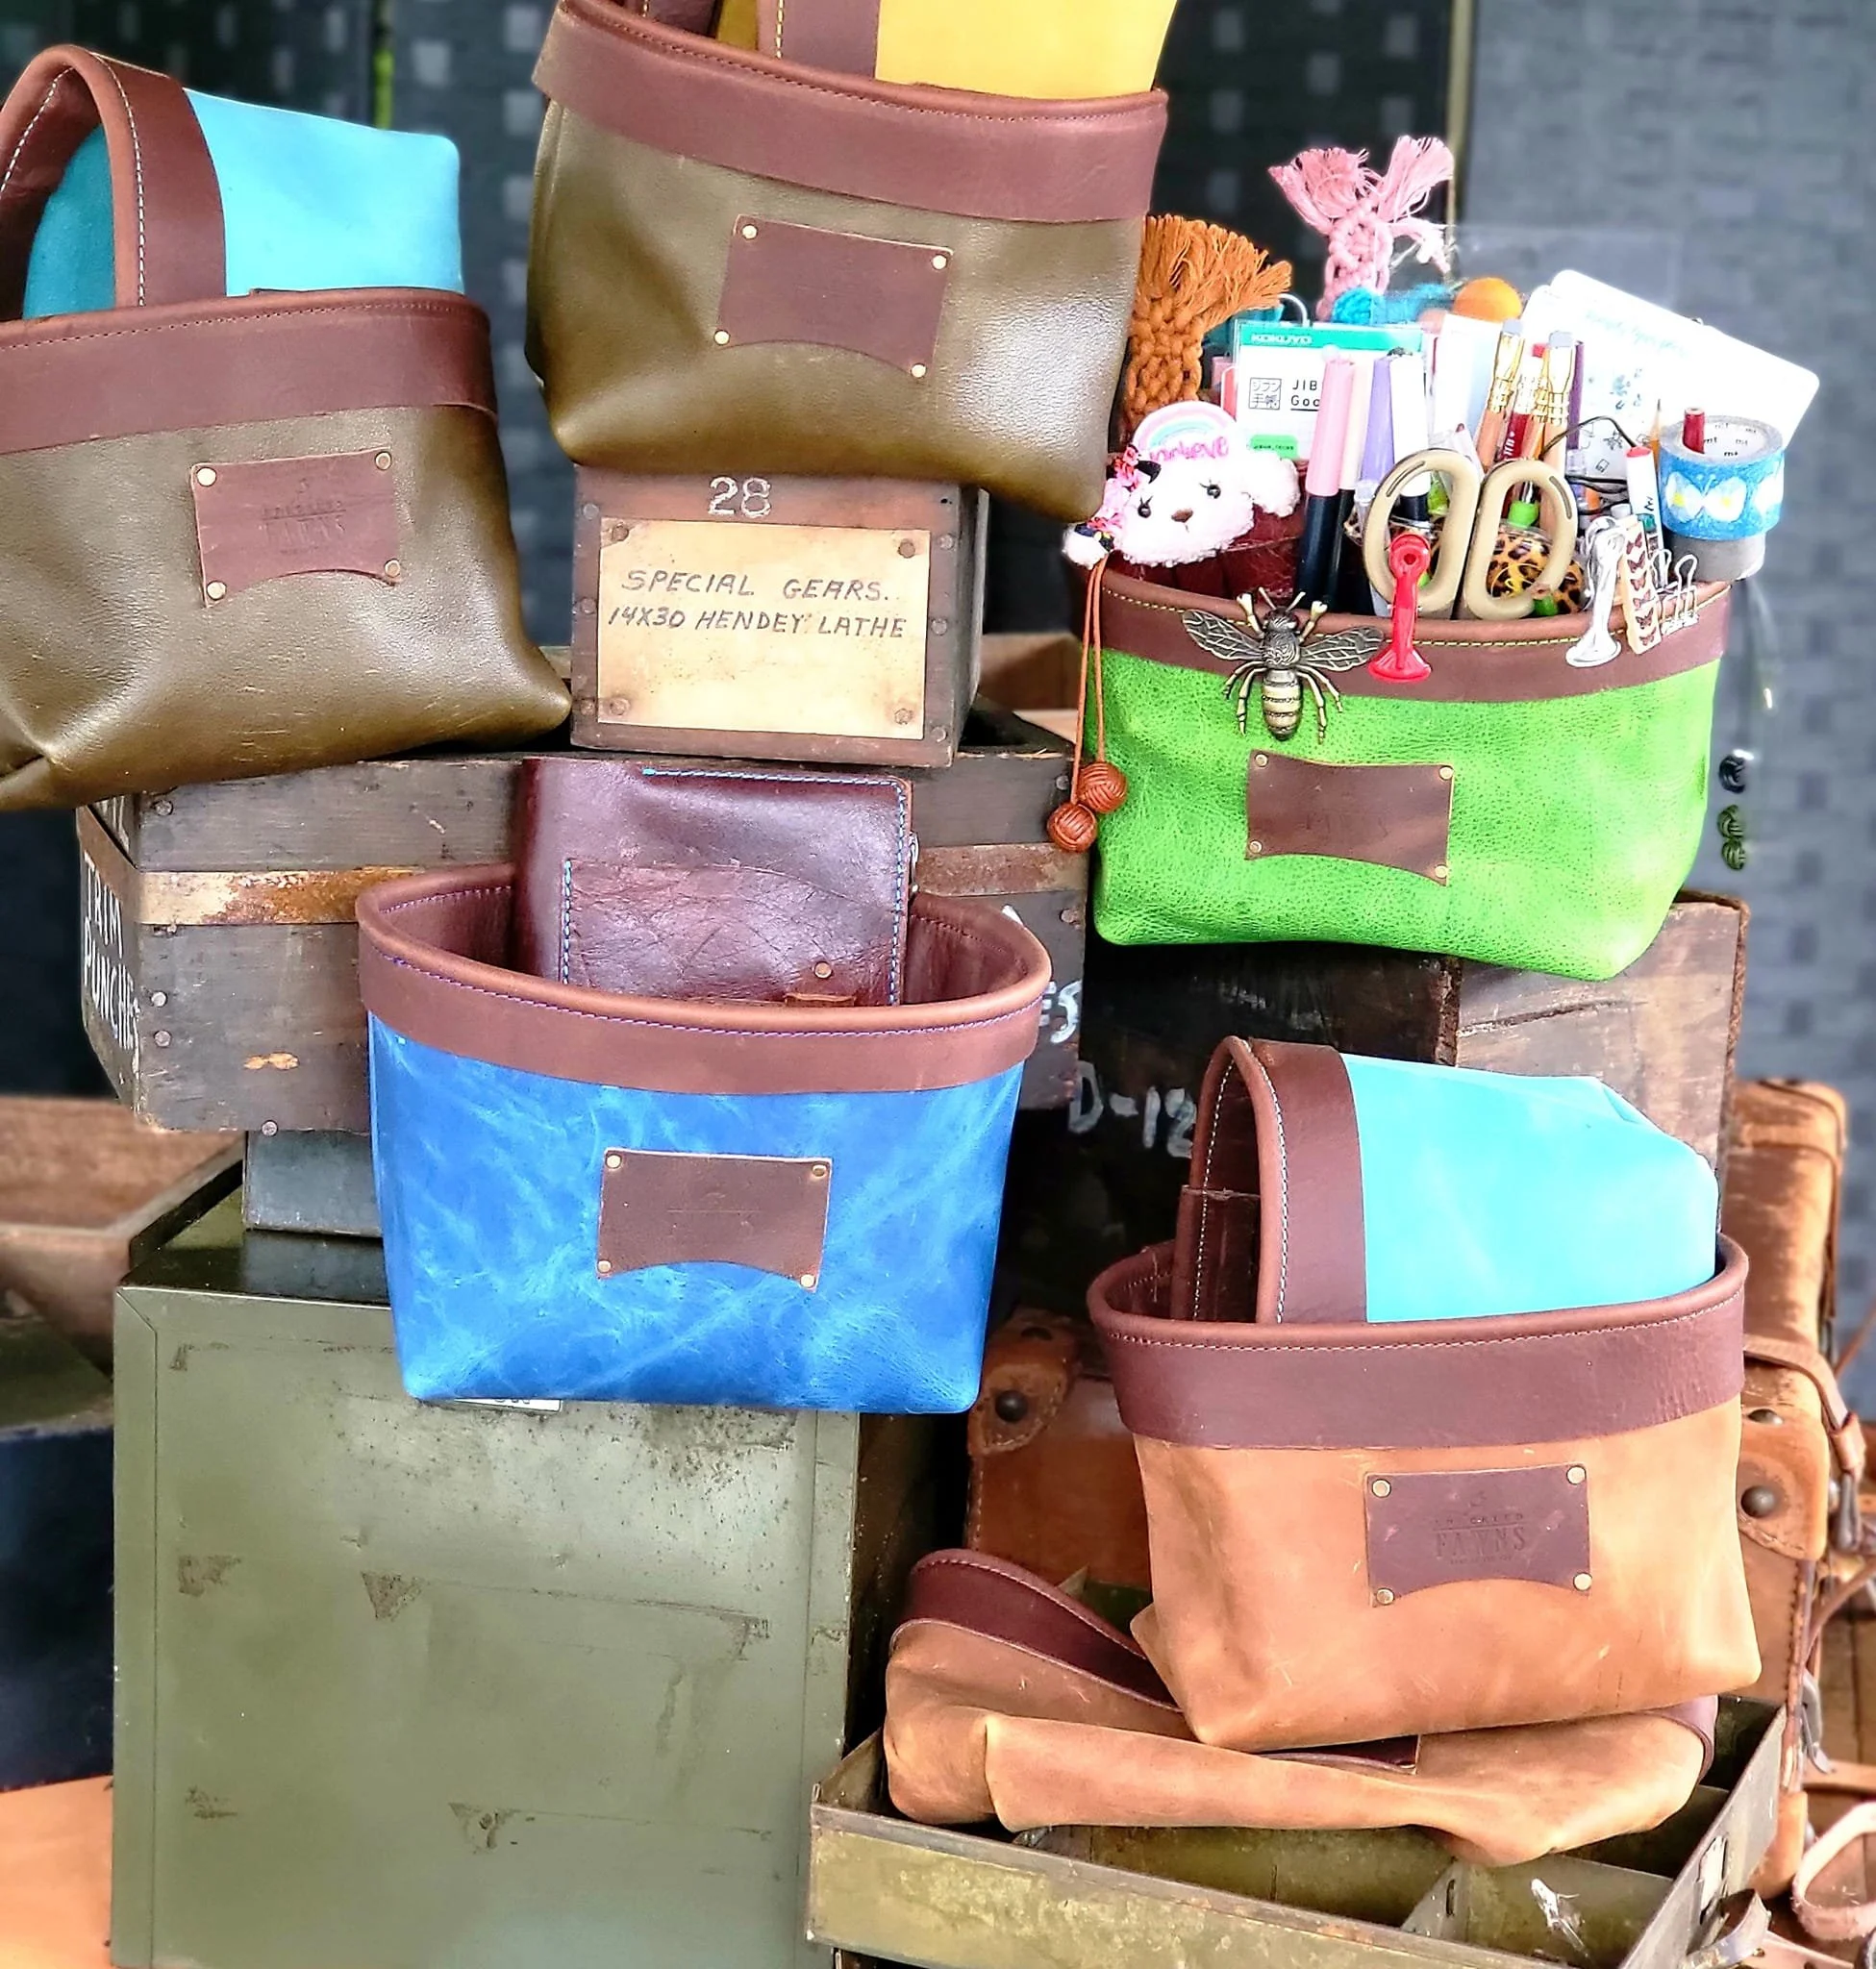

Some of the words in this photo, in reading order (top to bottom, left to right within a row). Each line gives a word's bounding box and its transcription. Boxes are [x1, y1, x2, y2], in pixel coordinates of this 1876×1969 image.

[708, 476, 771, 518] 28
[621, 569, 754, 595] SPECIAL
[783, 578, 888, 601] GEARS.
[608, 606, 686, 629] 14X30
[694, 609, 805, 634] HENDEY
[817, 615, 907, 638] LATHE
[84, 851, 123, 960] TRIM
